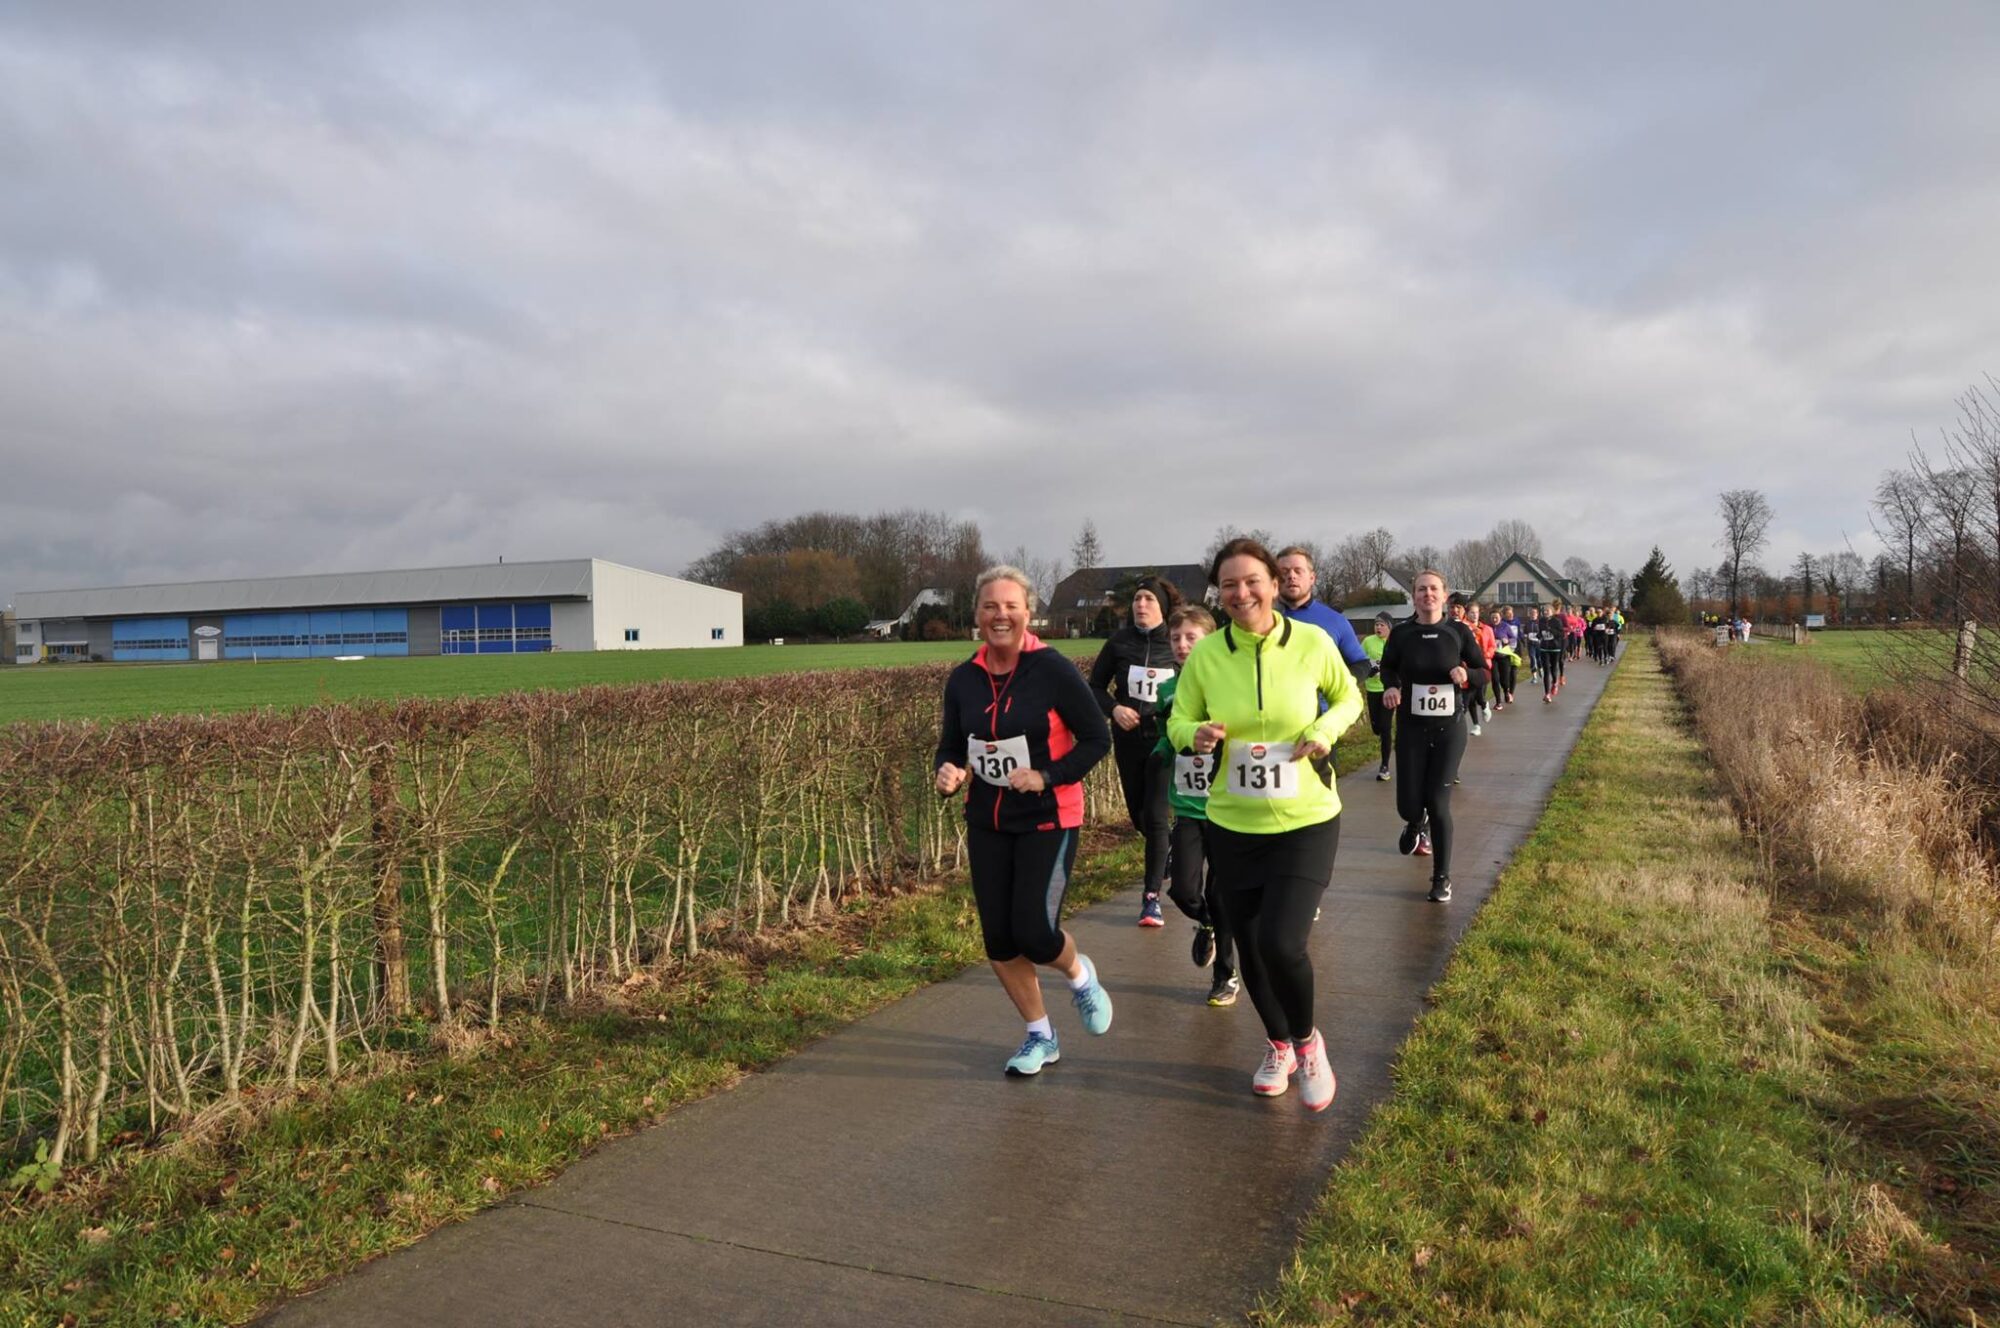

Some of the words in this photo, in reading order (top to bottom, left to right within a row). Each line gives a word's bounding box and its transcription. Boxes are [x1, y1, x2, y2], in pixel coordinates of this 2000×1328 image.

[1136, 680, 1158, 696] 11
[1418, 697, 1447, 711] 104
[977, 755, 1017, 778] 130
[1236, 764, 1281, 789] 131
